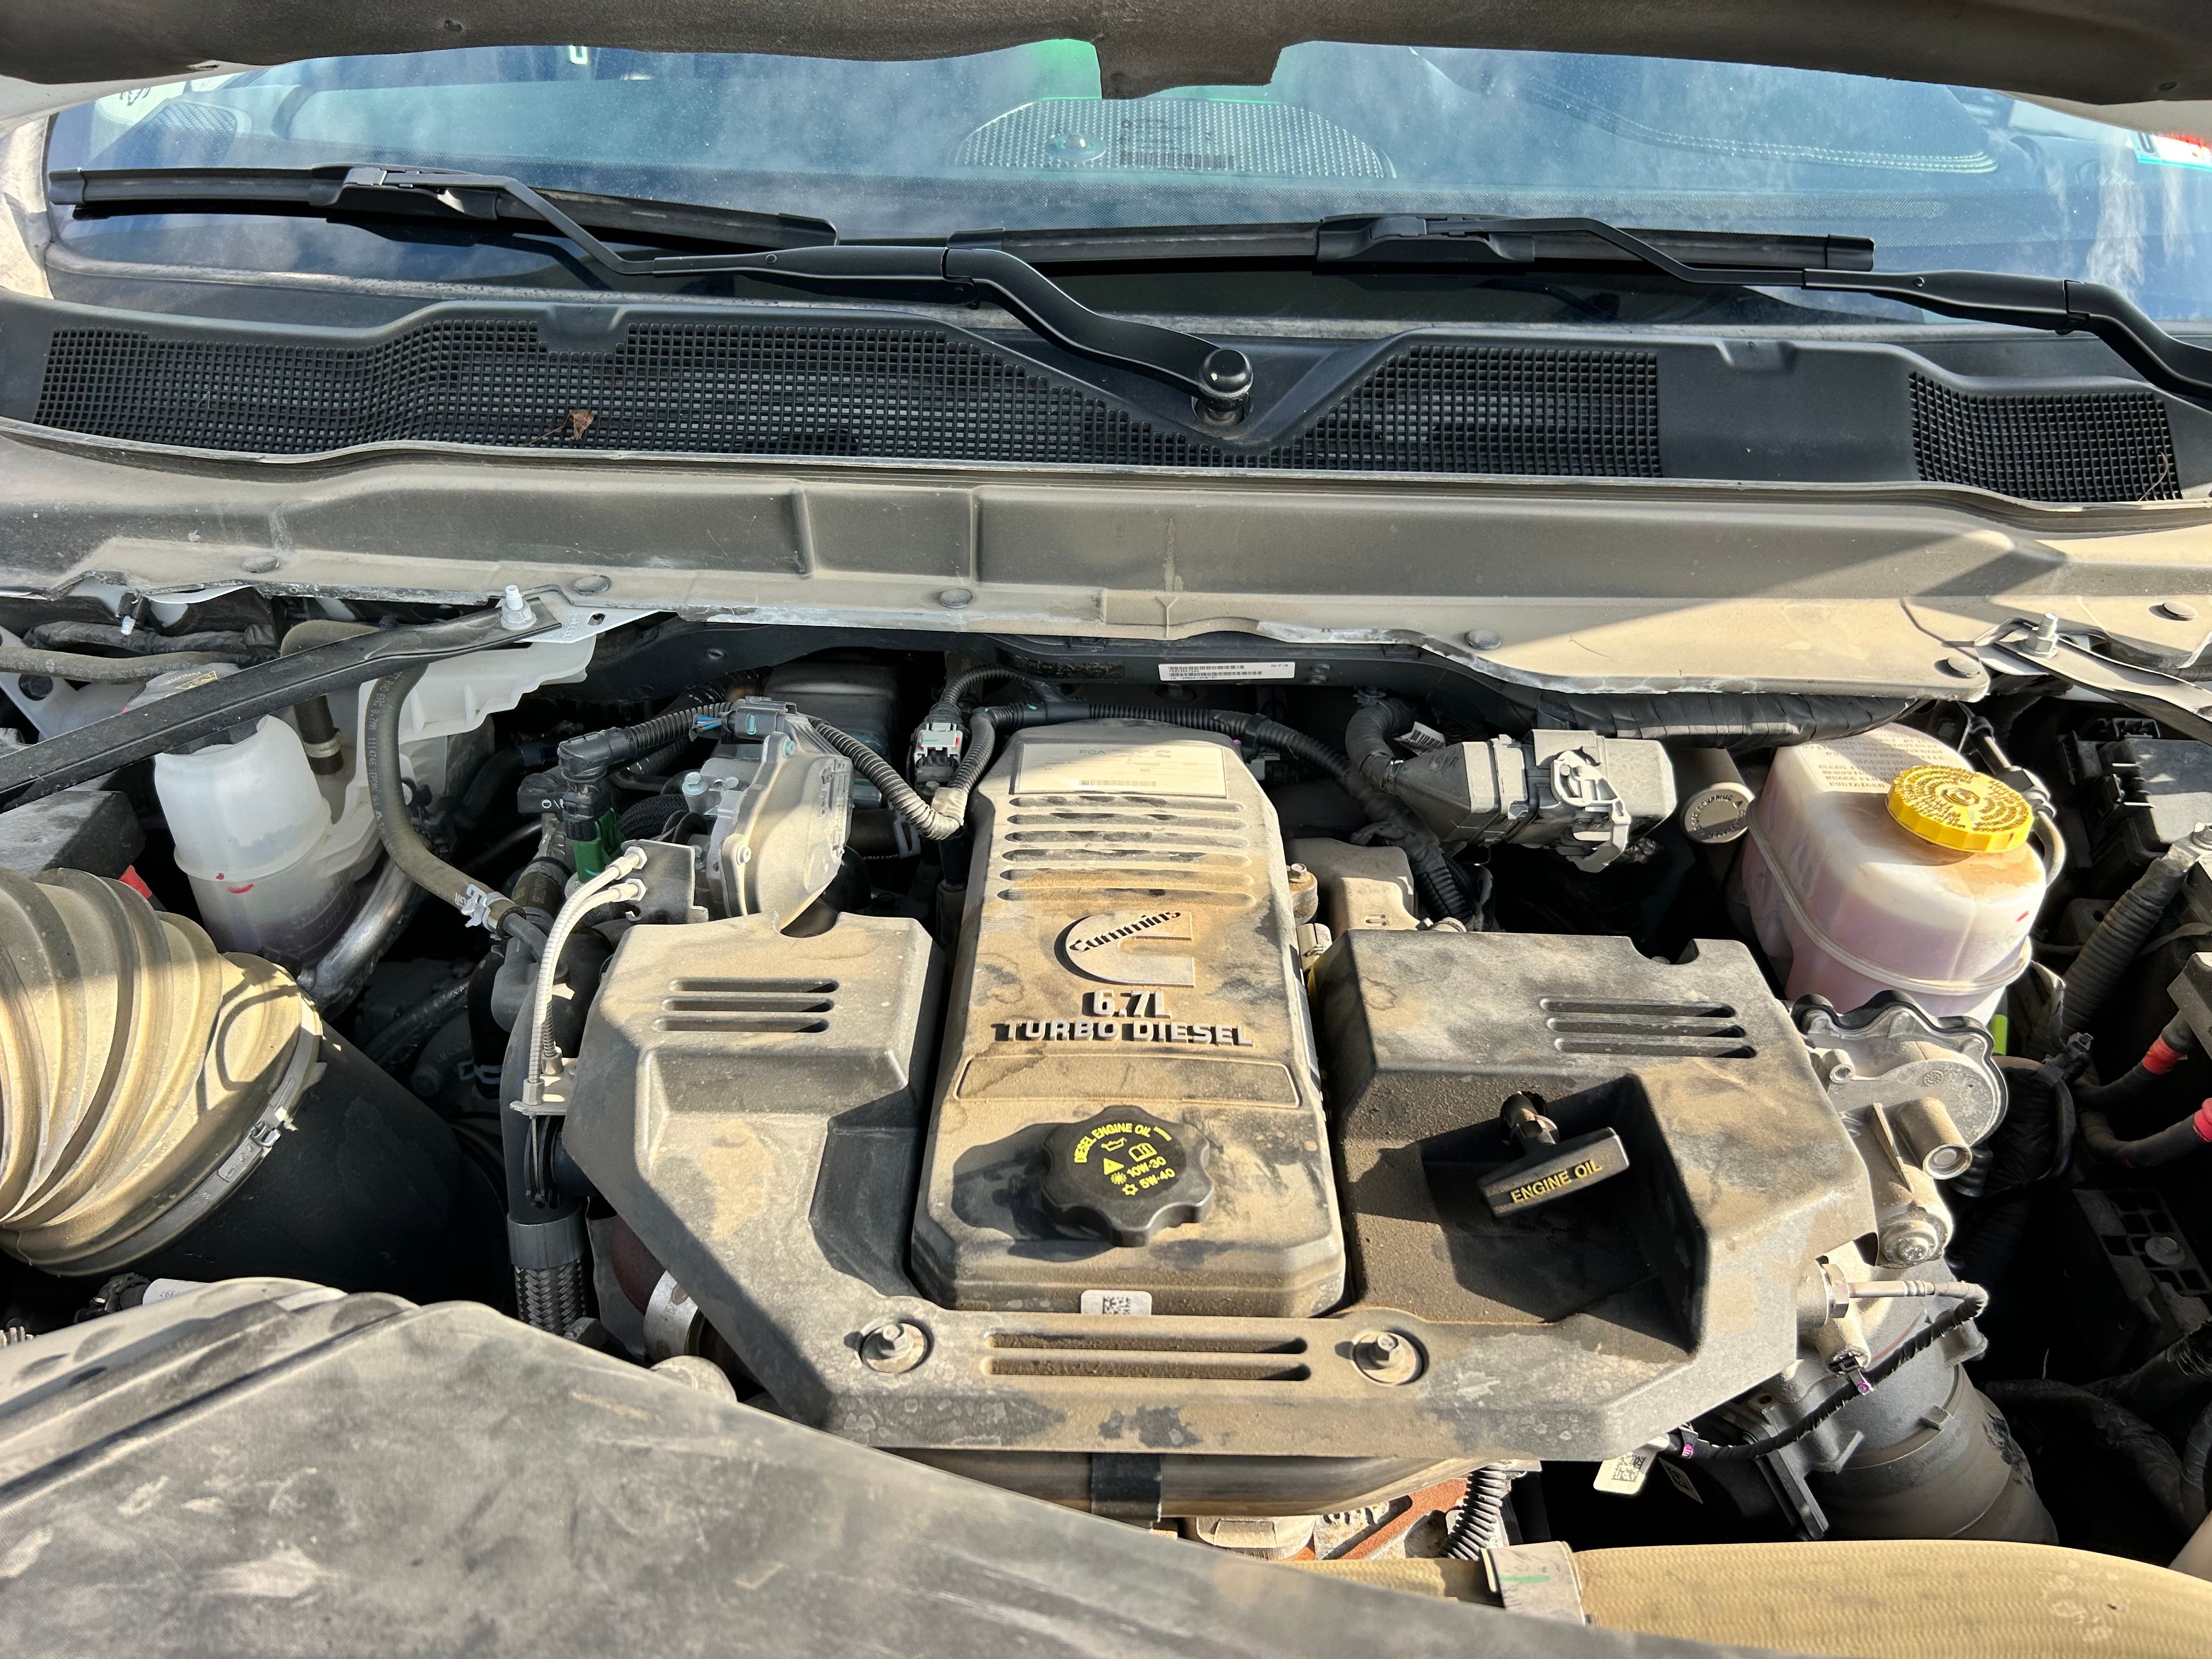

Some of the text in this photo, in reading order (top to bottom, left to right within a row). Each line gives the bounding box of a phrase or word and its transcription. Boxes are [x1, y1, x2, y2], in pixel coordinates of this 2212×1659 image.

[1067, 911, 1181, 953] Cummins
[1093, 989, 1172, 1019] 6.7L
[1005, 1019, 1254, 1048] TURBO DIESEL
[1074, 1136, 1097, 1163] DIESEL
[1091, 1122, 1133, 1139] ENGINE
[1135, 1124, 1151, 1138] OIL
[1126, 1156, 1167, 1178] 10W-30
[1139, 1167, 1176, 1189] 5W-40
[1510, 1159, 1603, 1204] ENGINE OIL
